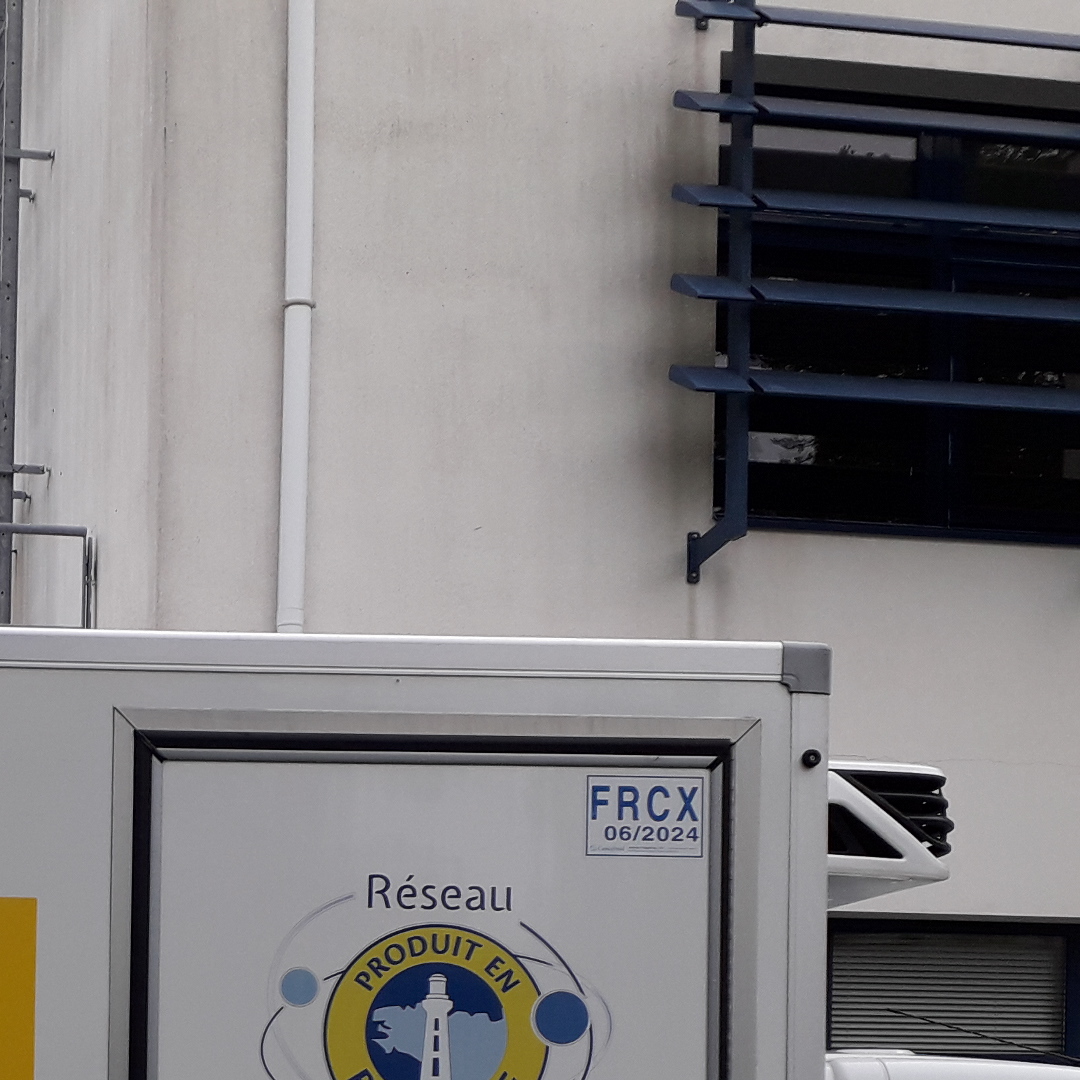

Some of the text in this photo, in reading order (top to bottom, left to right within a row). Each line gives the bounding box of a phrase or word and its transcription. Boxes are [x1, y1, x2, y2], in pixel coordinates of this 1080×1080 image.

[591, 785, 699, 822] FRCX
[604, 826, 699, 842] 06/2024
[367, 874, 512, 912] Réseau
[353, 932, 522, 994] PRODUIT EN
